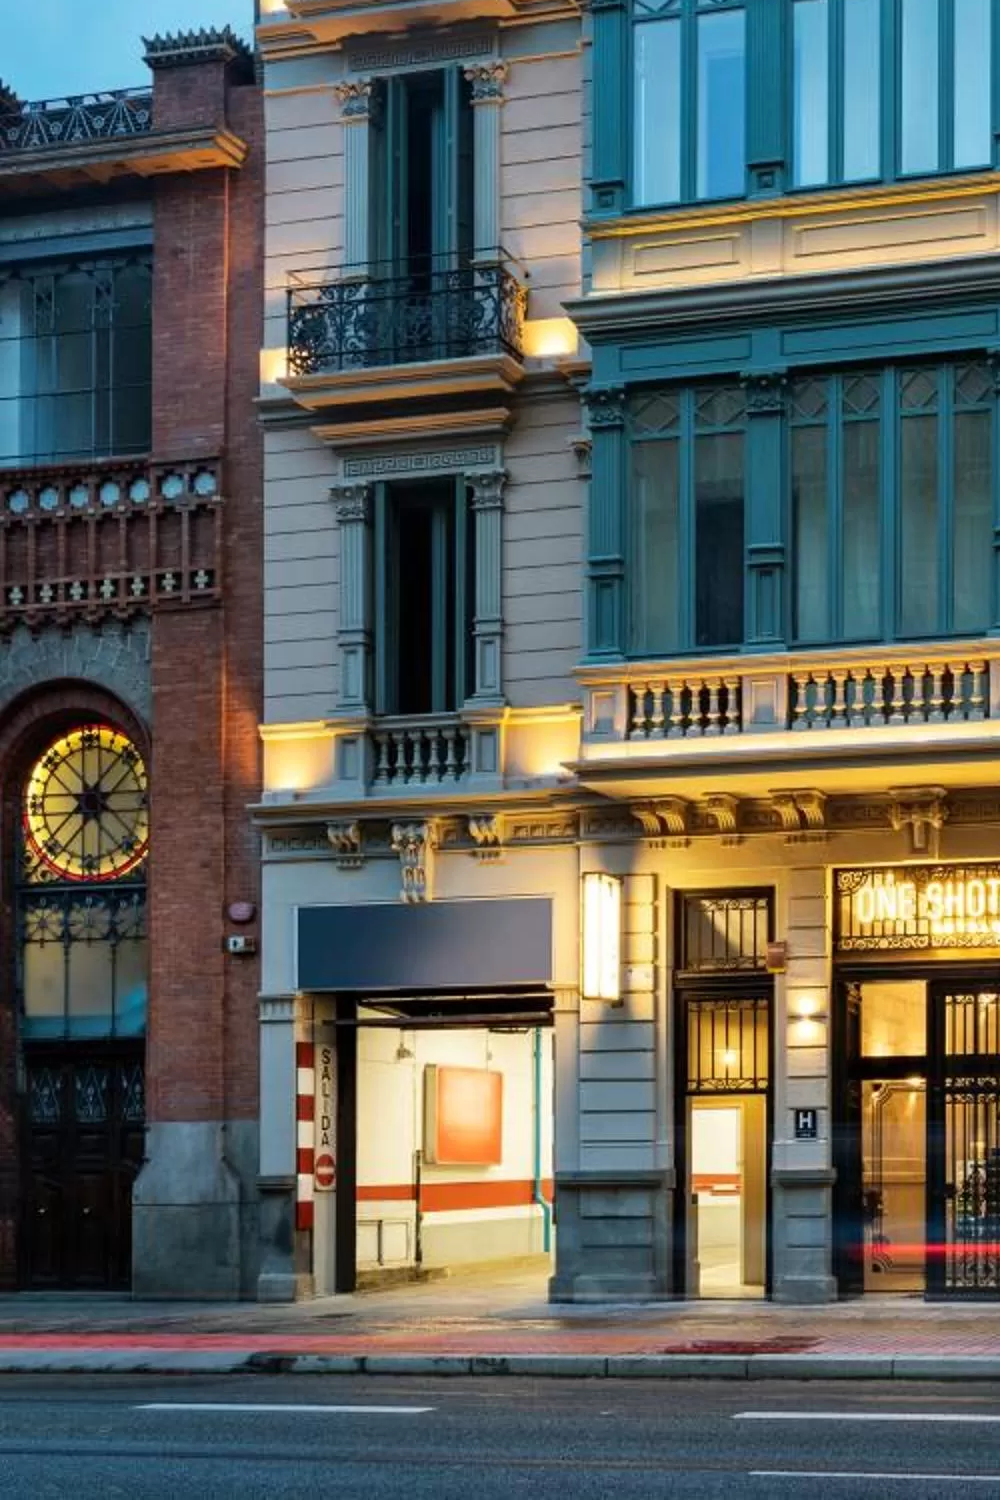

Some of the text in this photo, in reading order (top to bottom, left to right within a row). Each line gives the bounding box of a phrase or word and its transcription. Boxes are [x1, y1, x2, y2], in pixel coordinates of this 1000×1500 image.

[857, 882, 916, 923] ONE
[321, 1050, 331, 1147] SALIDA
[799, 1111, 813, 1129] H
